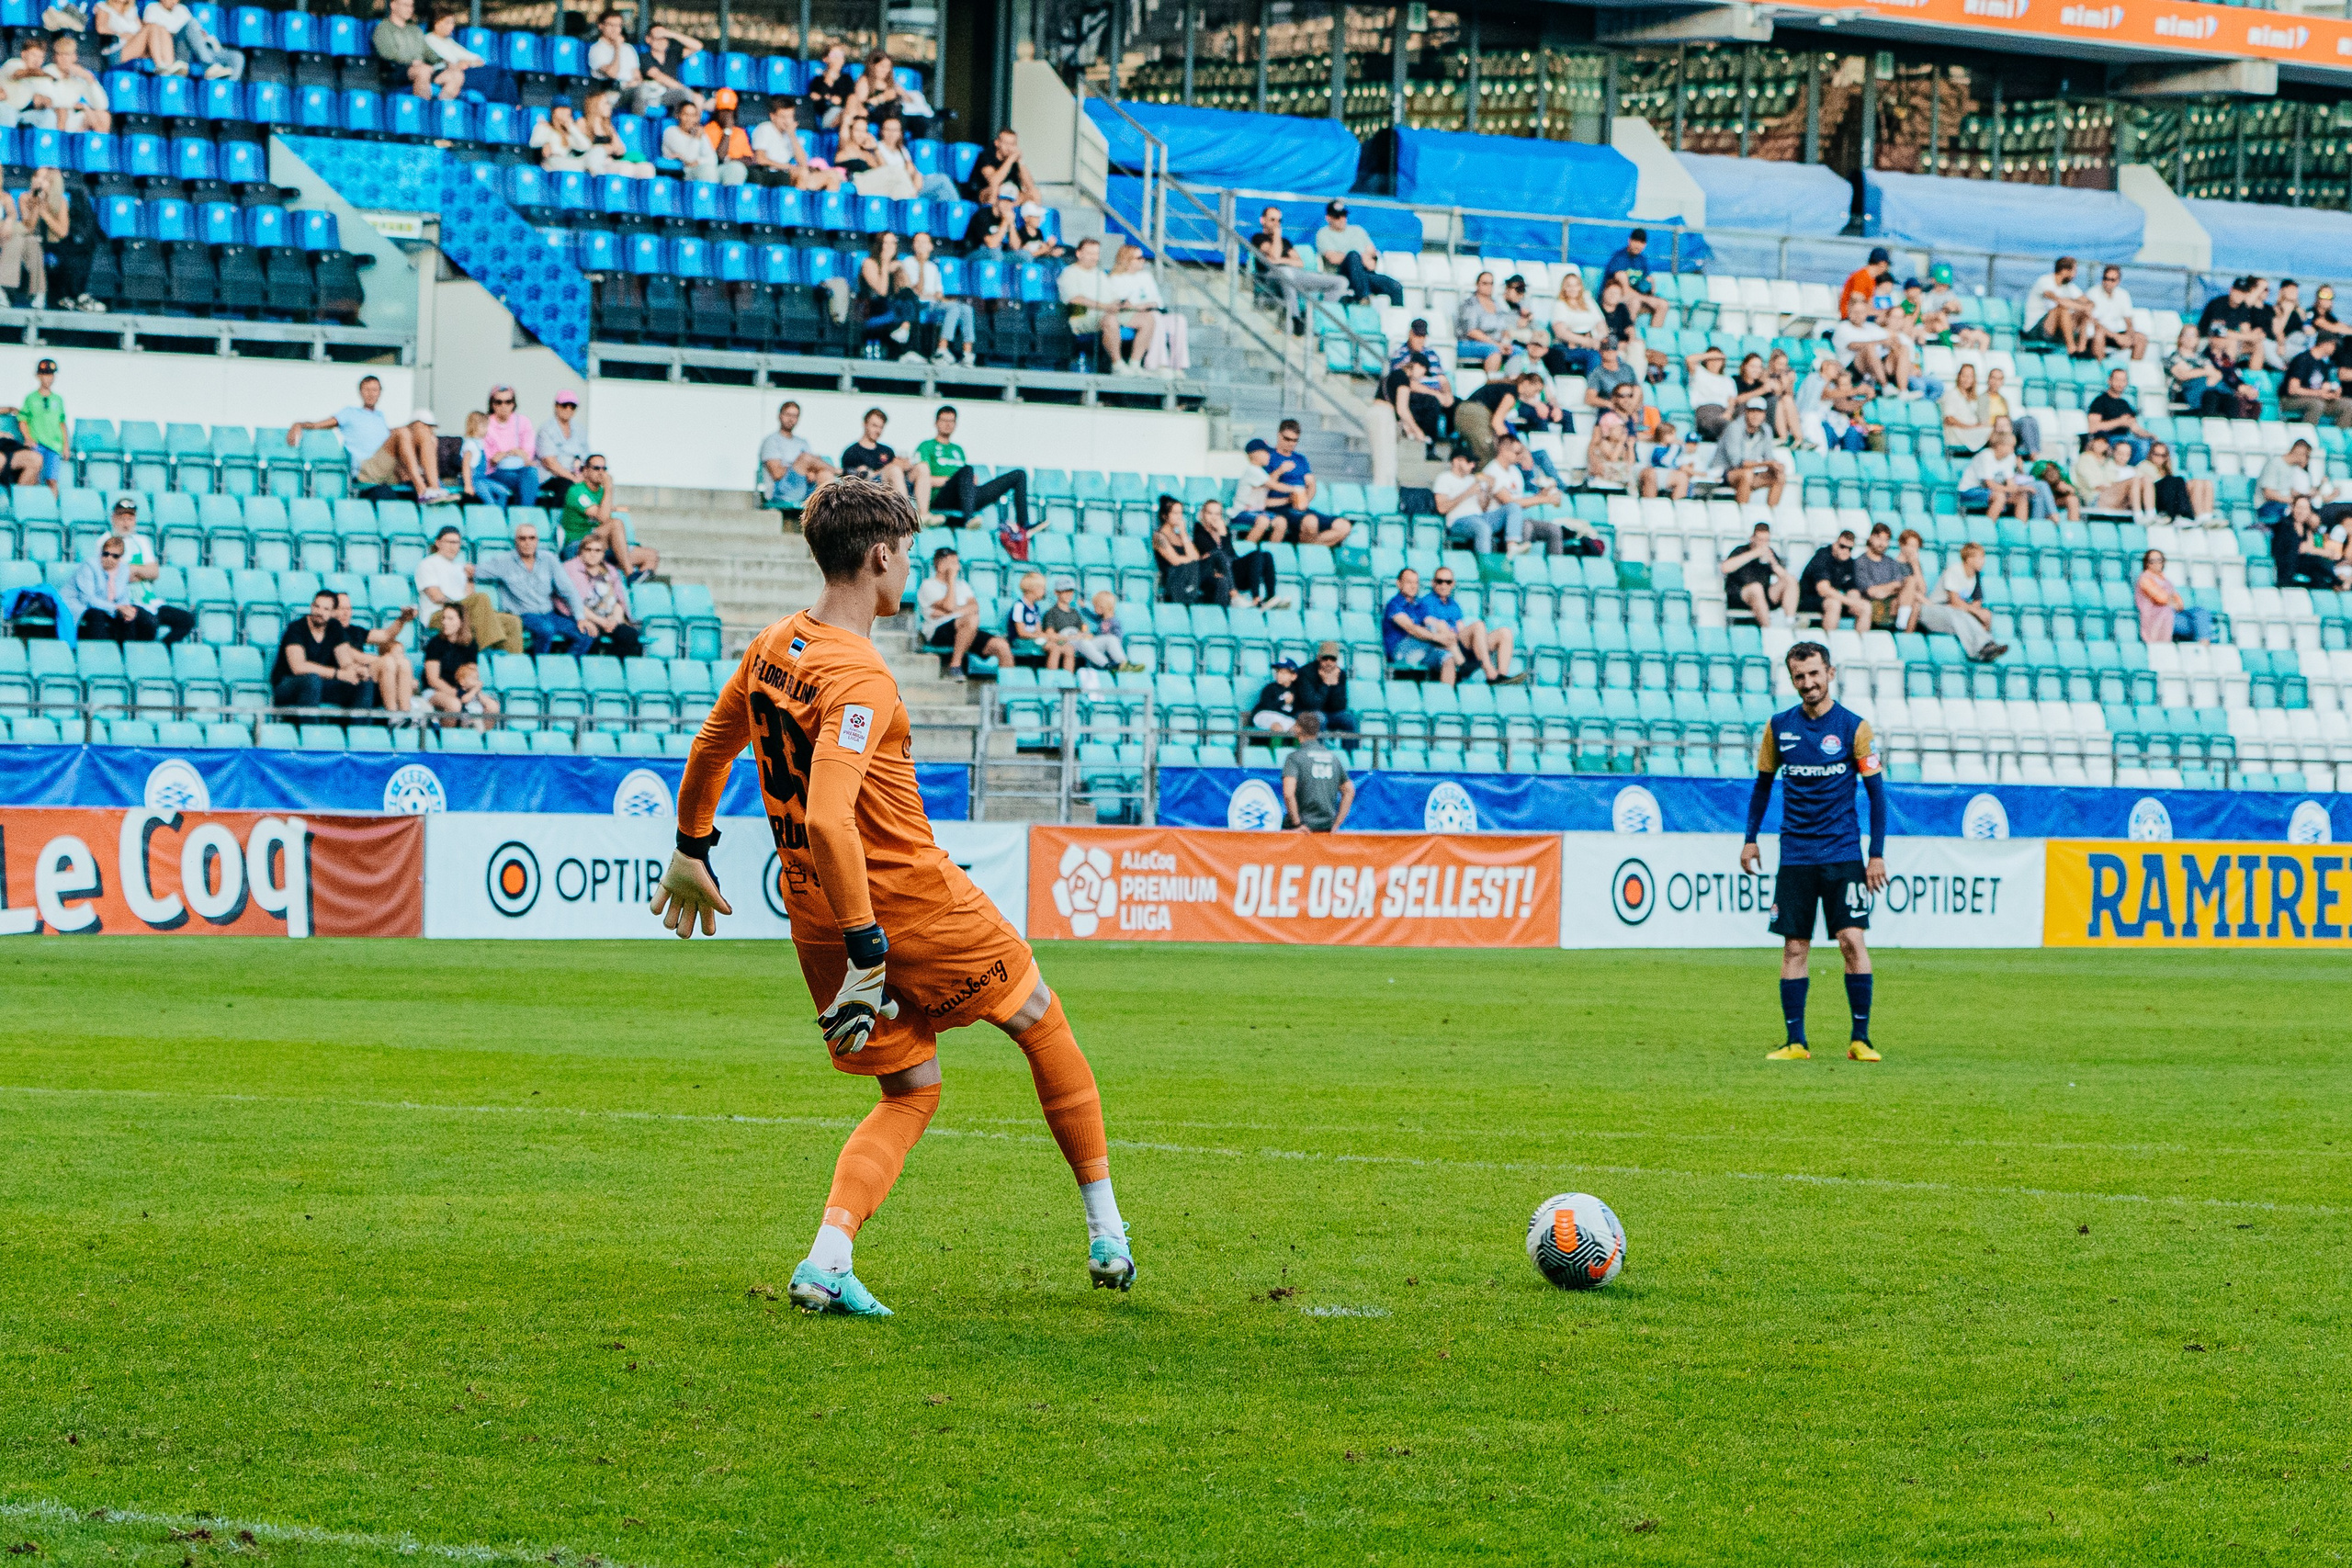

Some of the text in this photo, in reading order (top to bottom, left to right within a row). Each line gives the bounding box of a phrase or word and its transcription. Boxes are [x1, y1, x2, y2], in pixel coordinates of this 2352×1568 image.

[1788, 762, 1847, 777] SPORTLAND
[119, 807, 313, 938] Coq
[556, 857, 663, 902] OPTIB
[1120, 875, 1218, 902] PREMIUM
[1233, 863, 1537, 919] OLE OSA SELLEST!
[1668, 873, 1775, 912] OPTIBE
[1845, 882, 1869, 908] 49
[1886, 874, 2001, 914] OPTIBET
[2087, 852, 2352, 939] RAMIRE
[1120, 904, 1172, 931] LIIGA
